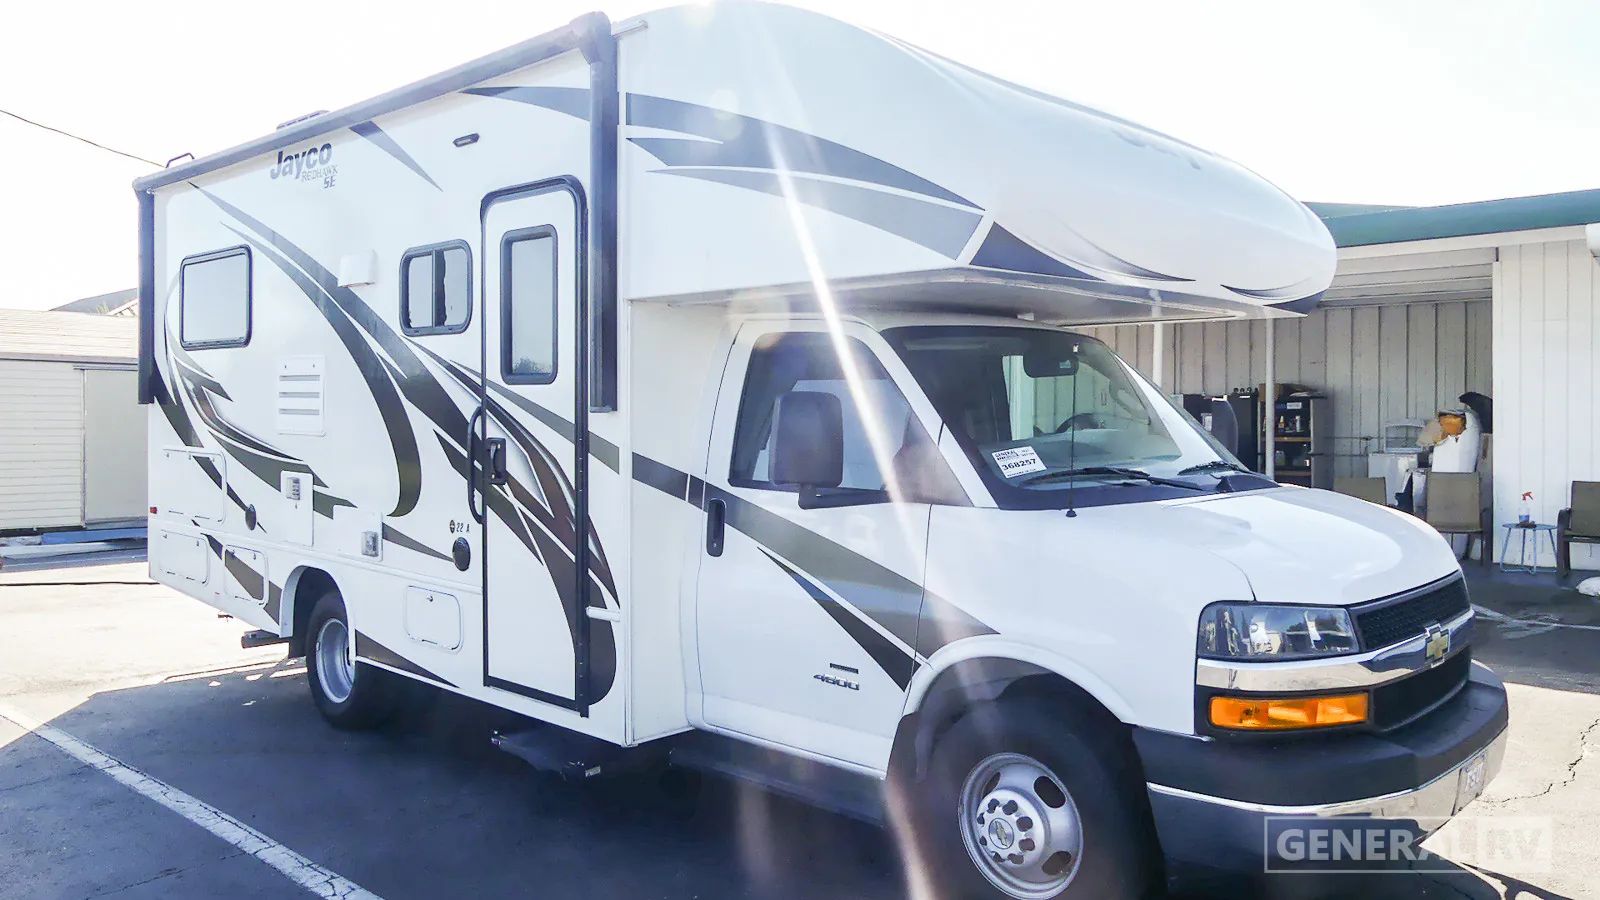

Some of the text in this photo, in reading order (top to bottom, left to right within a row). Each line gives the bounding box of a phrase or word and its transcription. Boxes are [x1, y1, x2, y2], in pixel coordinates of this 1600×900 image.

[270, 143, 332, 180] Jayco
[302, 165, 338, 182] REDHAWK
[323, 176, 336, 189] SE
[1002, 458, 1036, 471] 368257
